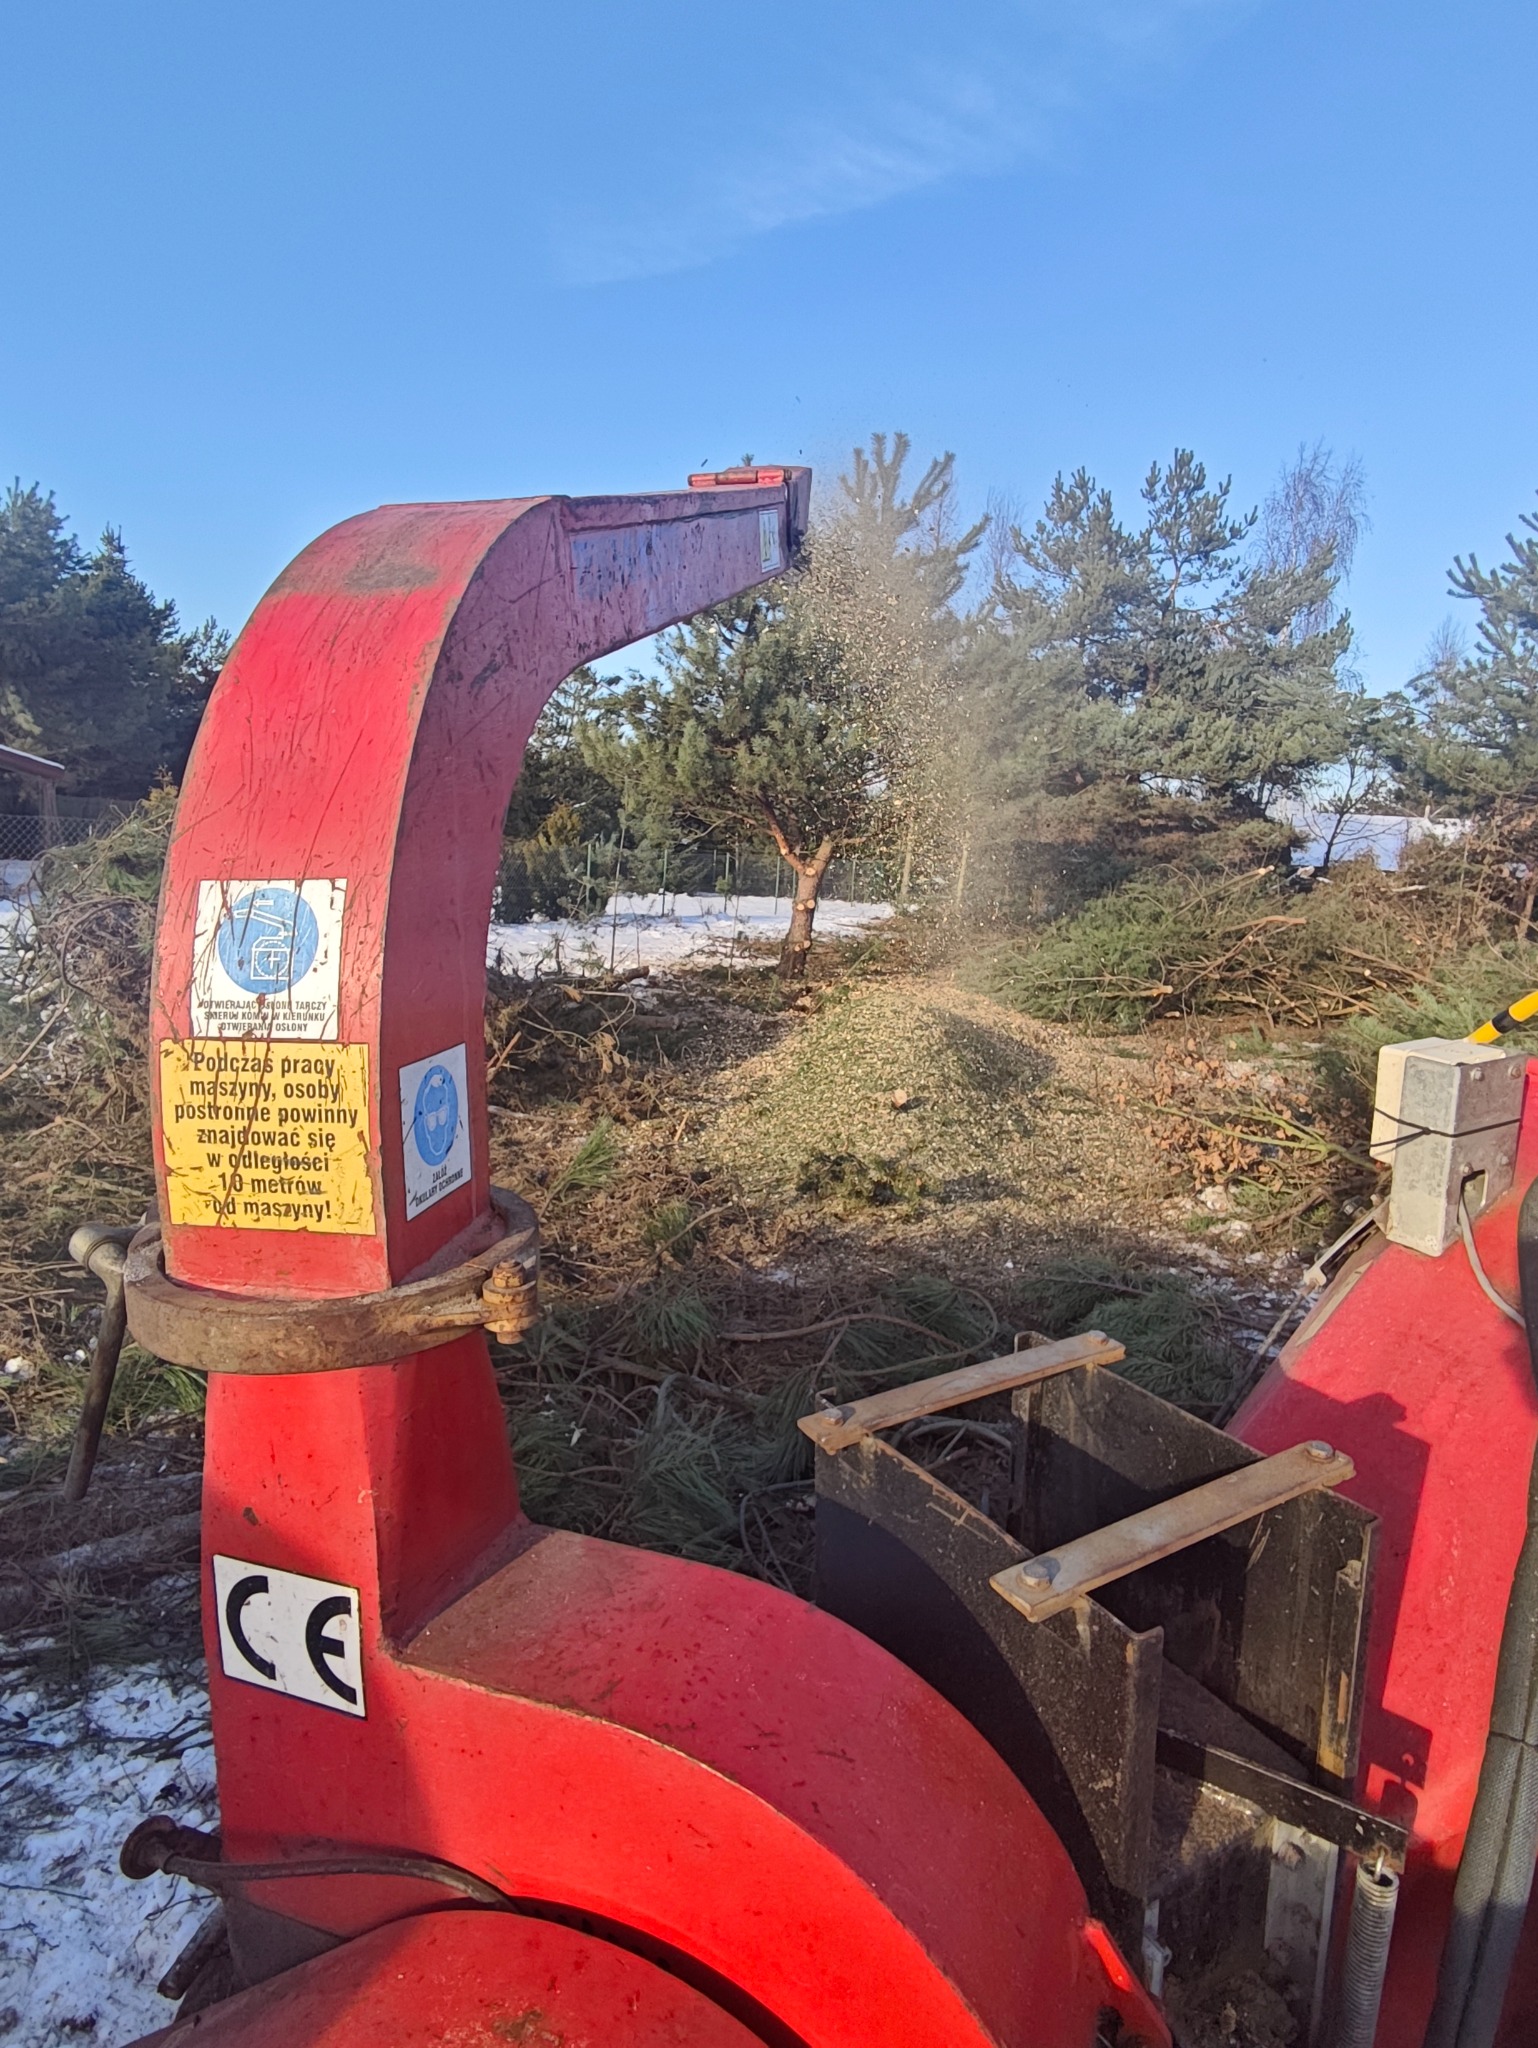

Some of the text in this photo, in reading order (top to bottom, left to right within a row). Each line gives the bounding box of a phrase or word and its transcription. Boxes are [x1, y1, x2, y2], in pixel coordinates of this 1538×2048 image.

[283, 1012, 325, 1021] KIERUNKU
[295, 1001, 327, 1010] TARCZY
[275, 1023, 308, 1032] OSŁONY
[192, 1052, 336, 1079] Podczas pracy
[189, 1080, 339, 1102] maszyny, osoby
[174, 1102, 358, 1128] postronne powinny
[197, 1126, 336, 1152] znajdować się
[206, 1150, 330, 1174] w odległości
[217, 1172, 323, 1194] 10 metrów
[212, 1197, 331, 1222] od maszyny!
[226, 1575, 357, 1705] CE
